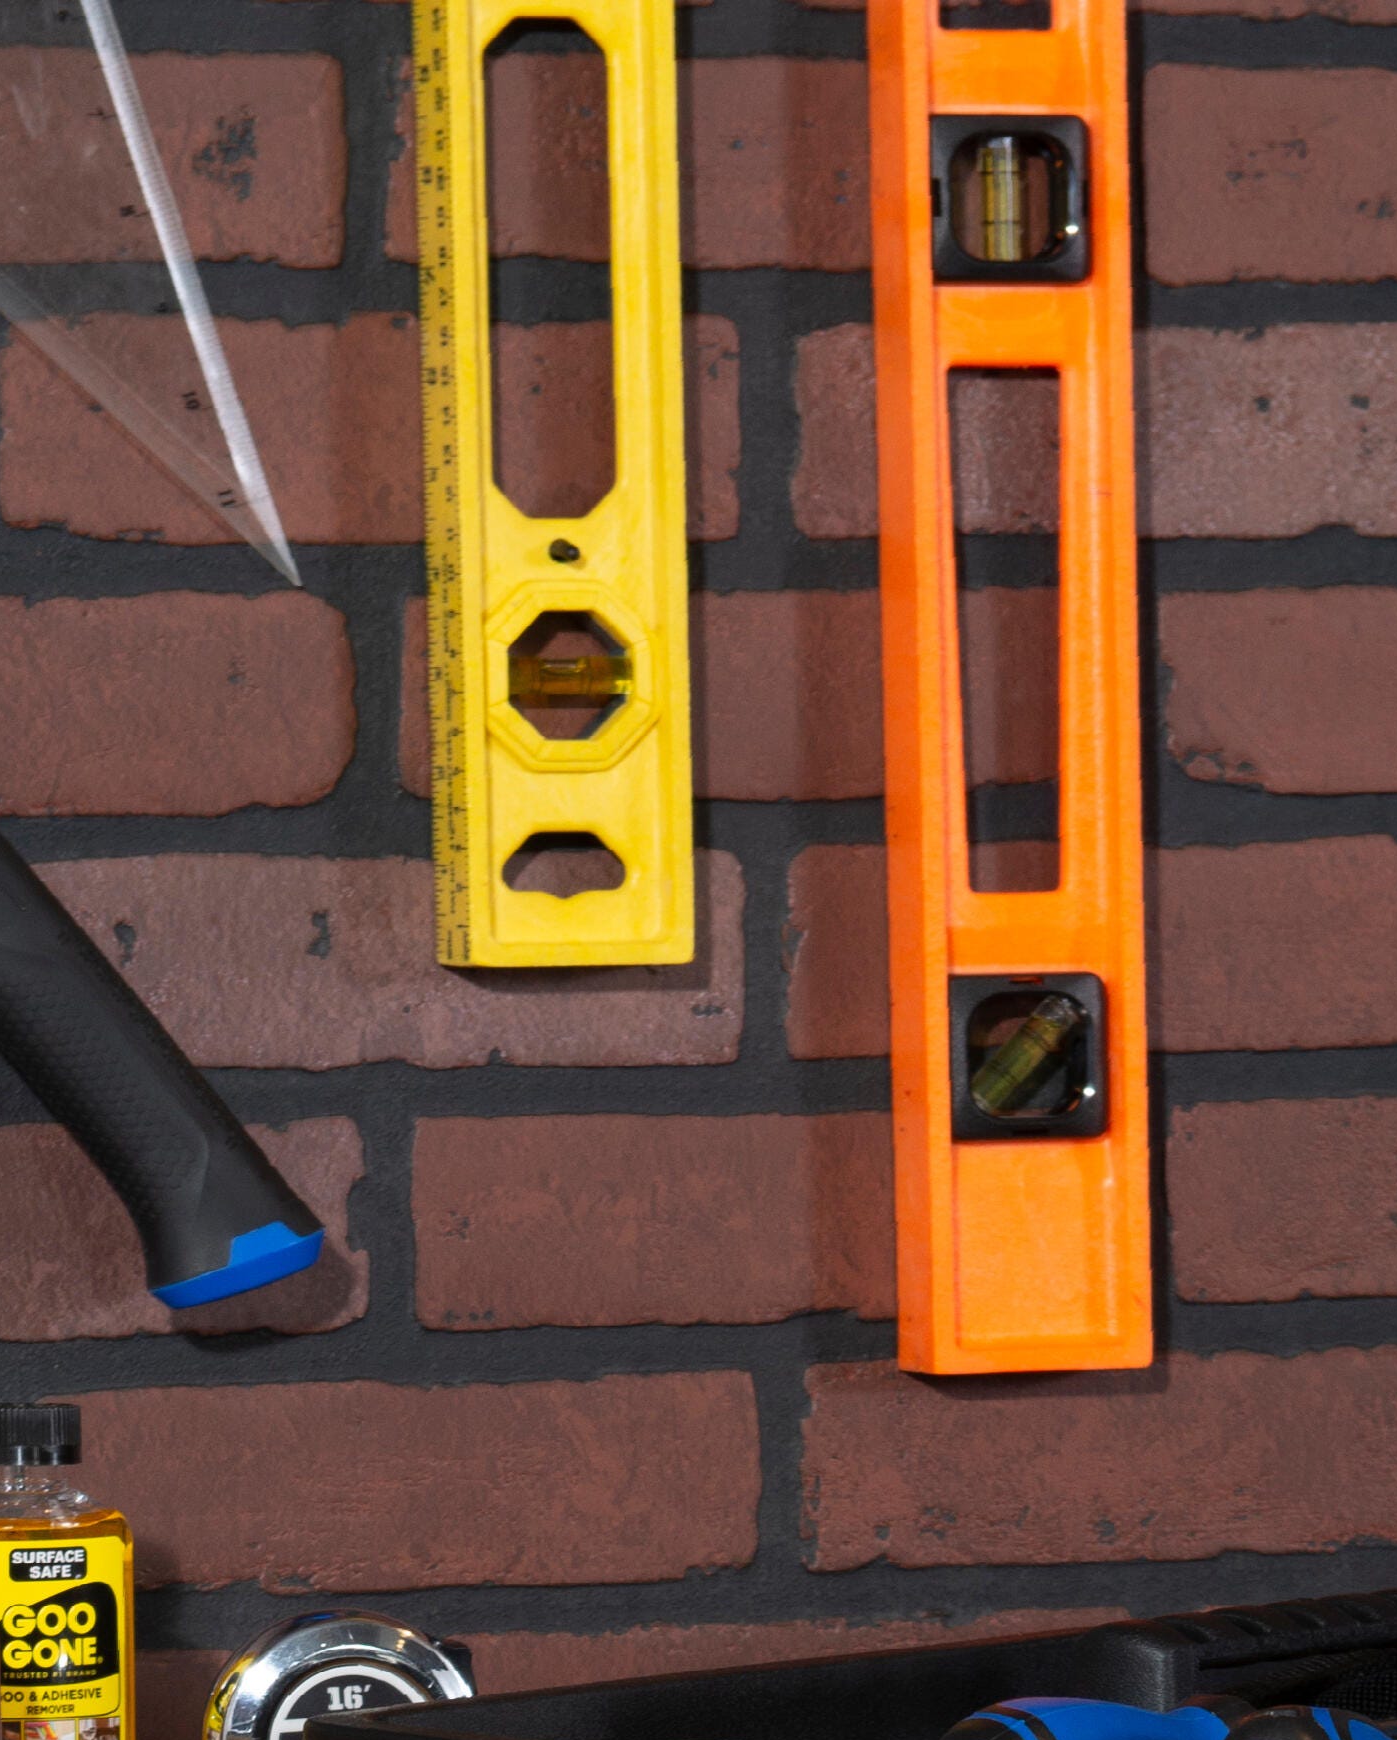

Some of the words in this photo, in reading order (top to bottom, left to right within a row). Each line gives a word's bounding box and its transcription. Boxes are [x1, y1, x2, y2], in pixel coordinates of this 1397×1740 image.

[11, 1549, 85, 1564] SURFACE
[29, 1565, 72, 1579] SAFE
[2, 1602, 97, 1638] GOO
[2, 1637, 97, 1669] GONE
[3, 1671, 48, 1680] TRUSTED
[29, 1690, 37, 1702] &
[42, 1688, 102, 1702] ADHESIVE
[26, 1704, 75, 1717] REMOVER
